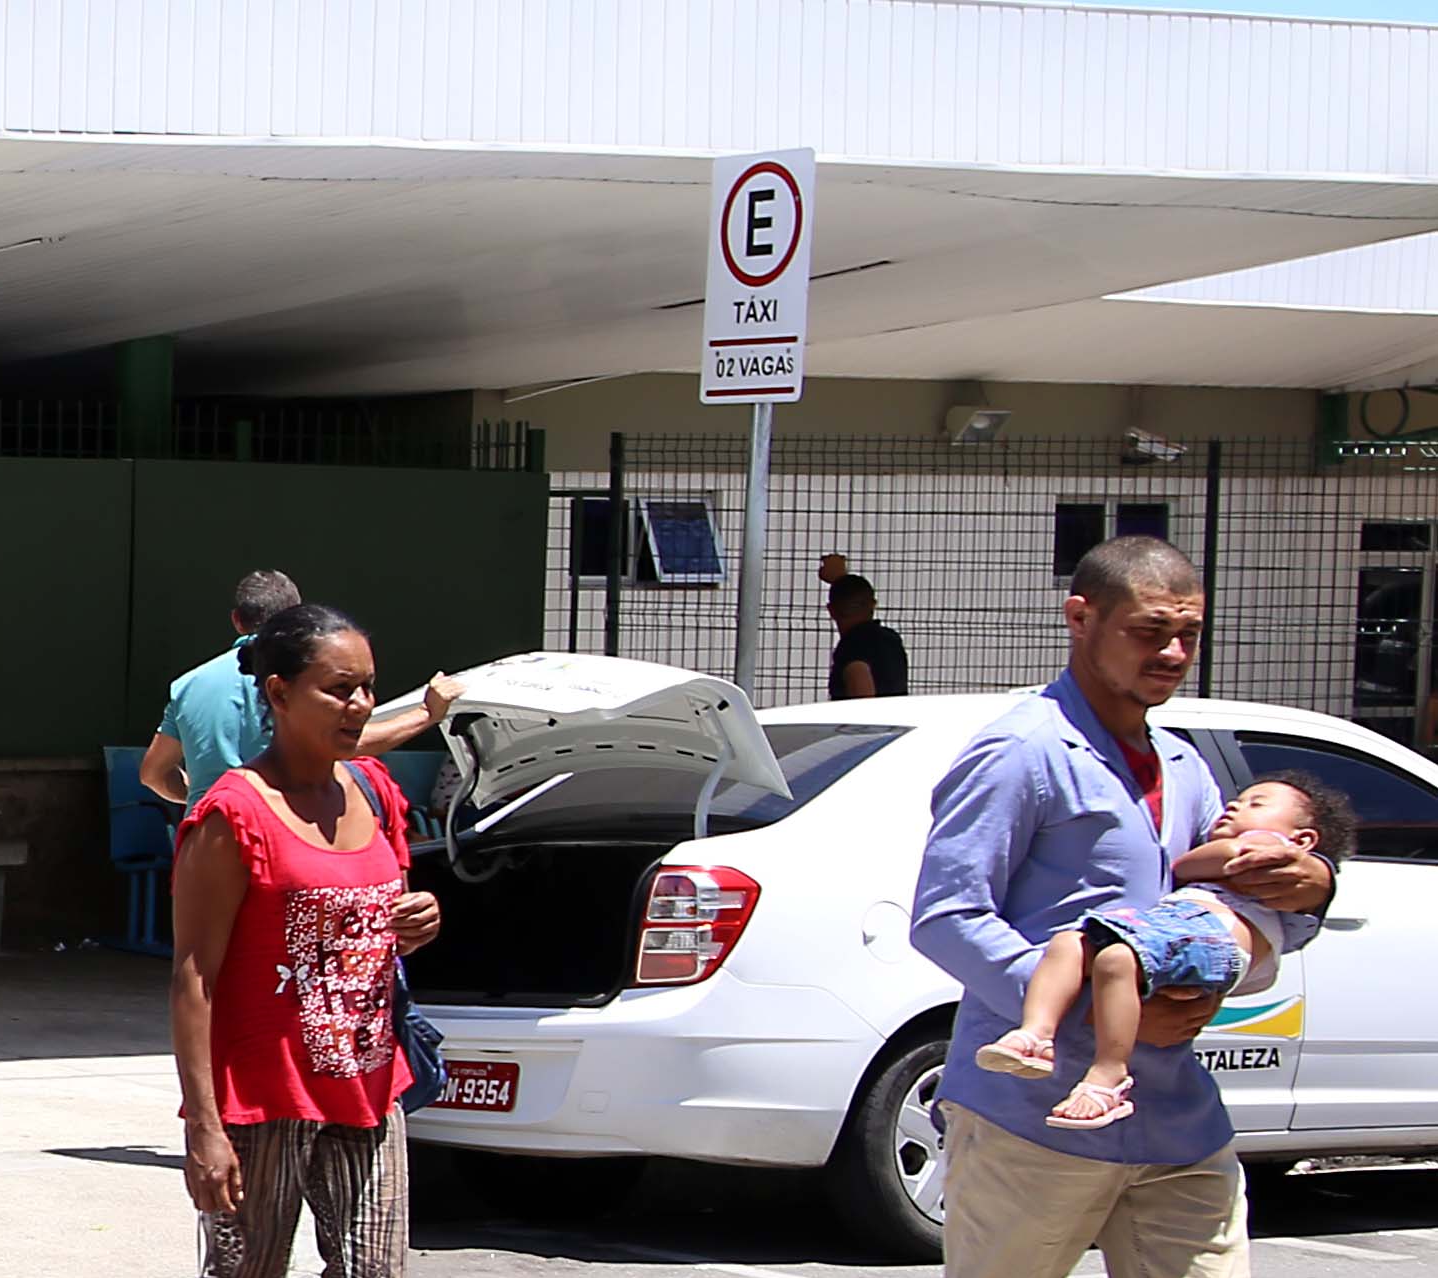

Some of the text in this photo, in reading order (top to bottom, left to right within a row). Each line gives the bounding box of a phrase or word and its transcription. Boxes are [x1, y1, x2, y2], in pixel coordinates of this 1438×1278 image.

[746, 189, 774, 257] E
[733, 295, 778, 324] TÁXI
[716, 355, 794, 378] 02 VAGAS
